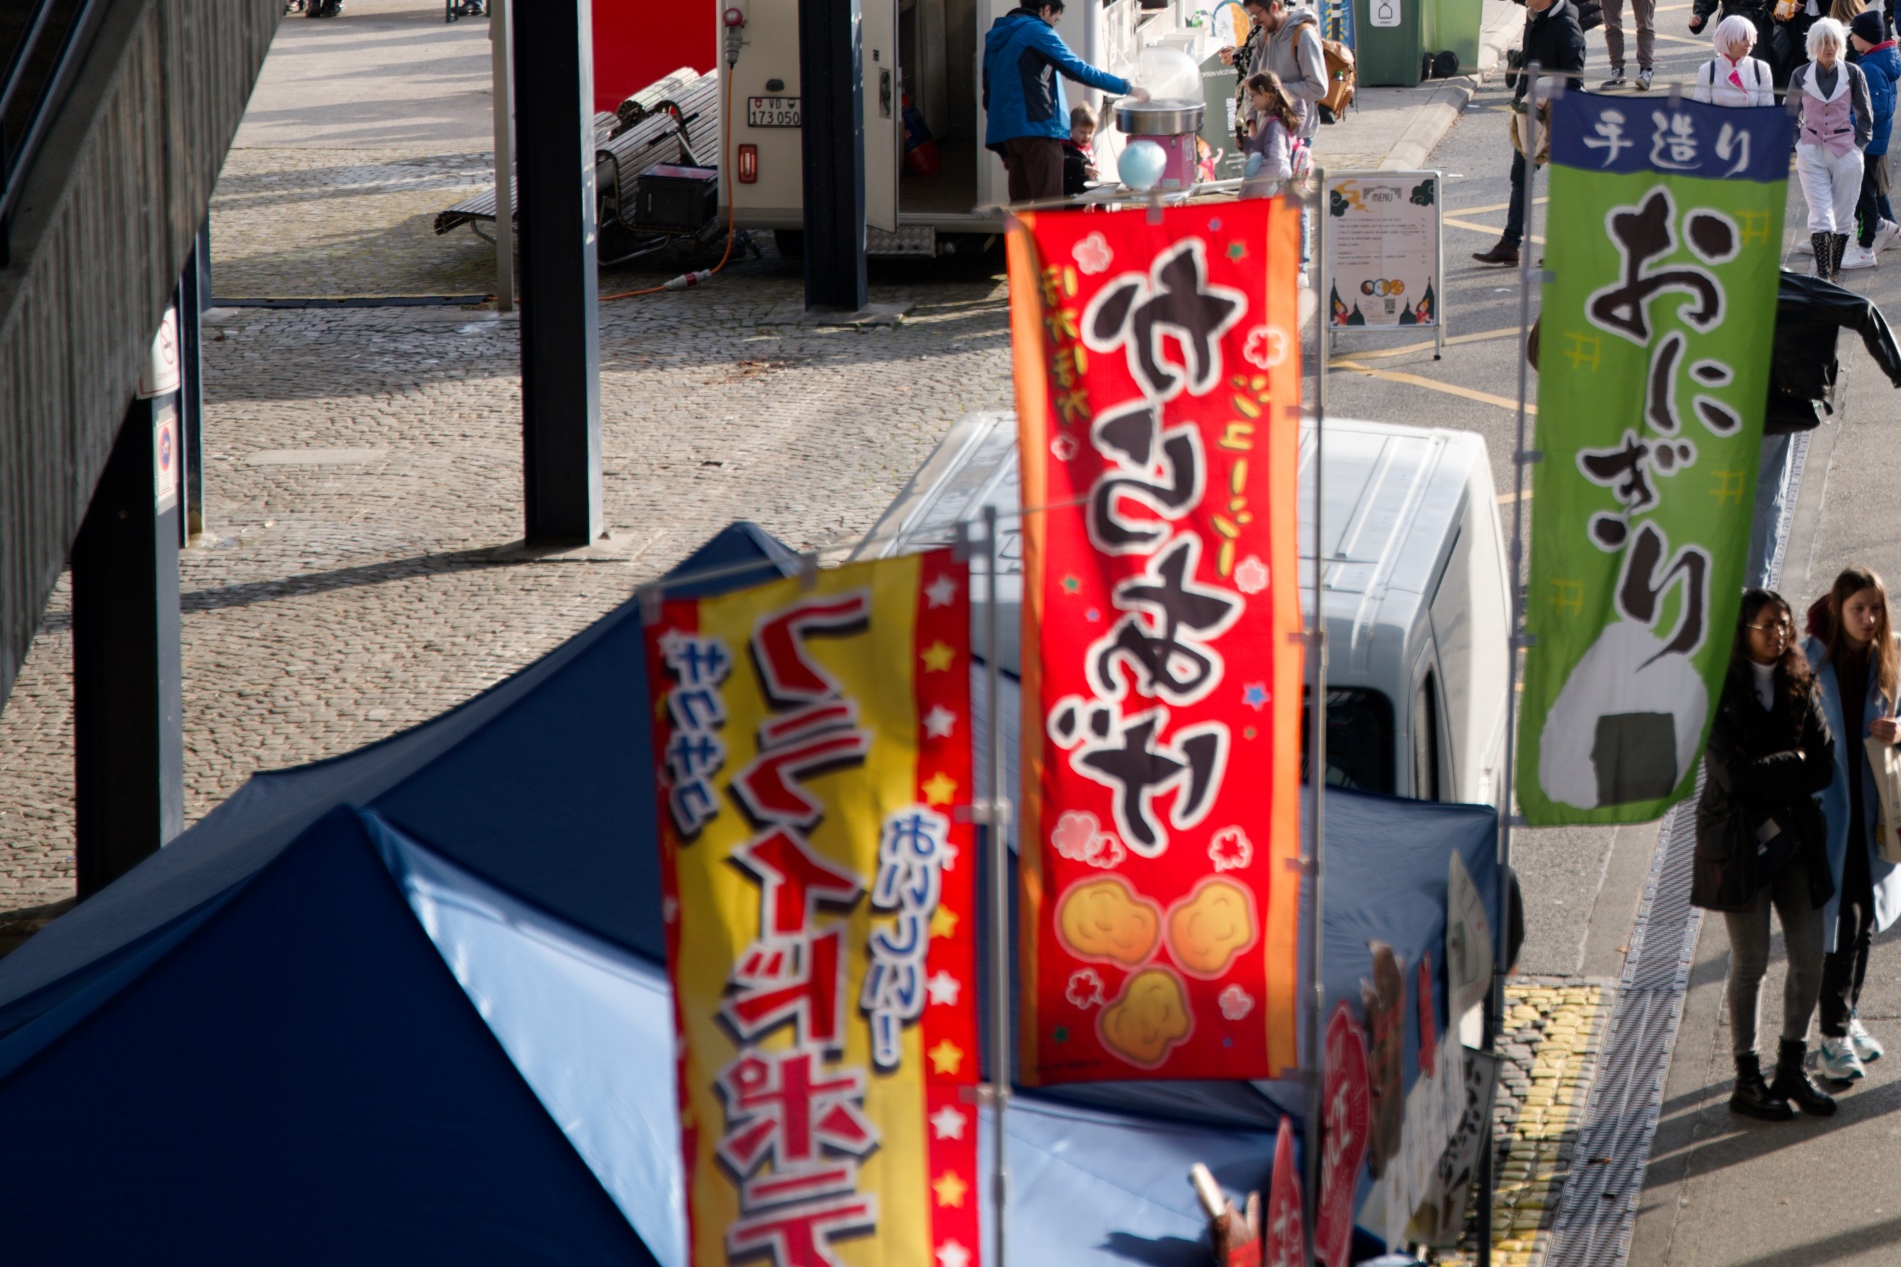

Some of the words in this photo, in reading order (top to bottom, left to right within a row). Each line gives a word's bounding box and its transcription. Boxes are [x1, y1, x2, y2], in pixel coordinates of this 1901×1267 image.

[769, 99, 781, 109] VD
[751, 111, 774, 125] 173
[777, 111, 800, 125] 050
[1583, 110, 1753, 173] 手造り
[1371, 193, 1393, 202] MENU
[1578, 188, 1741, 673] おにぎり
